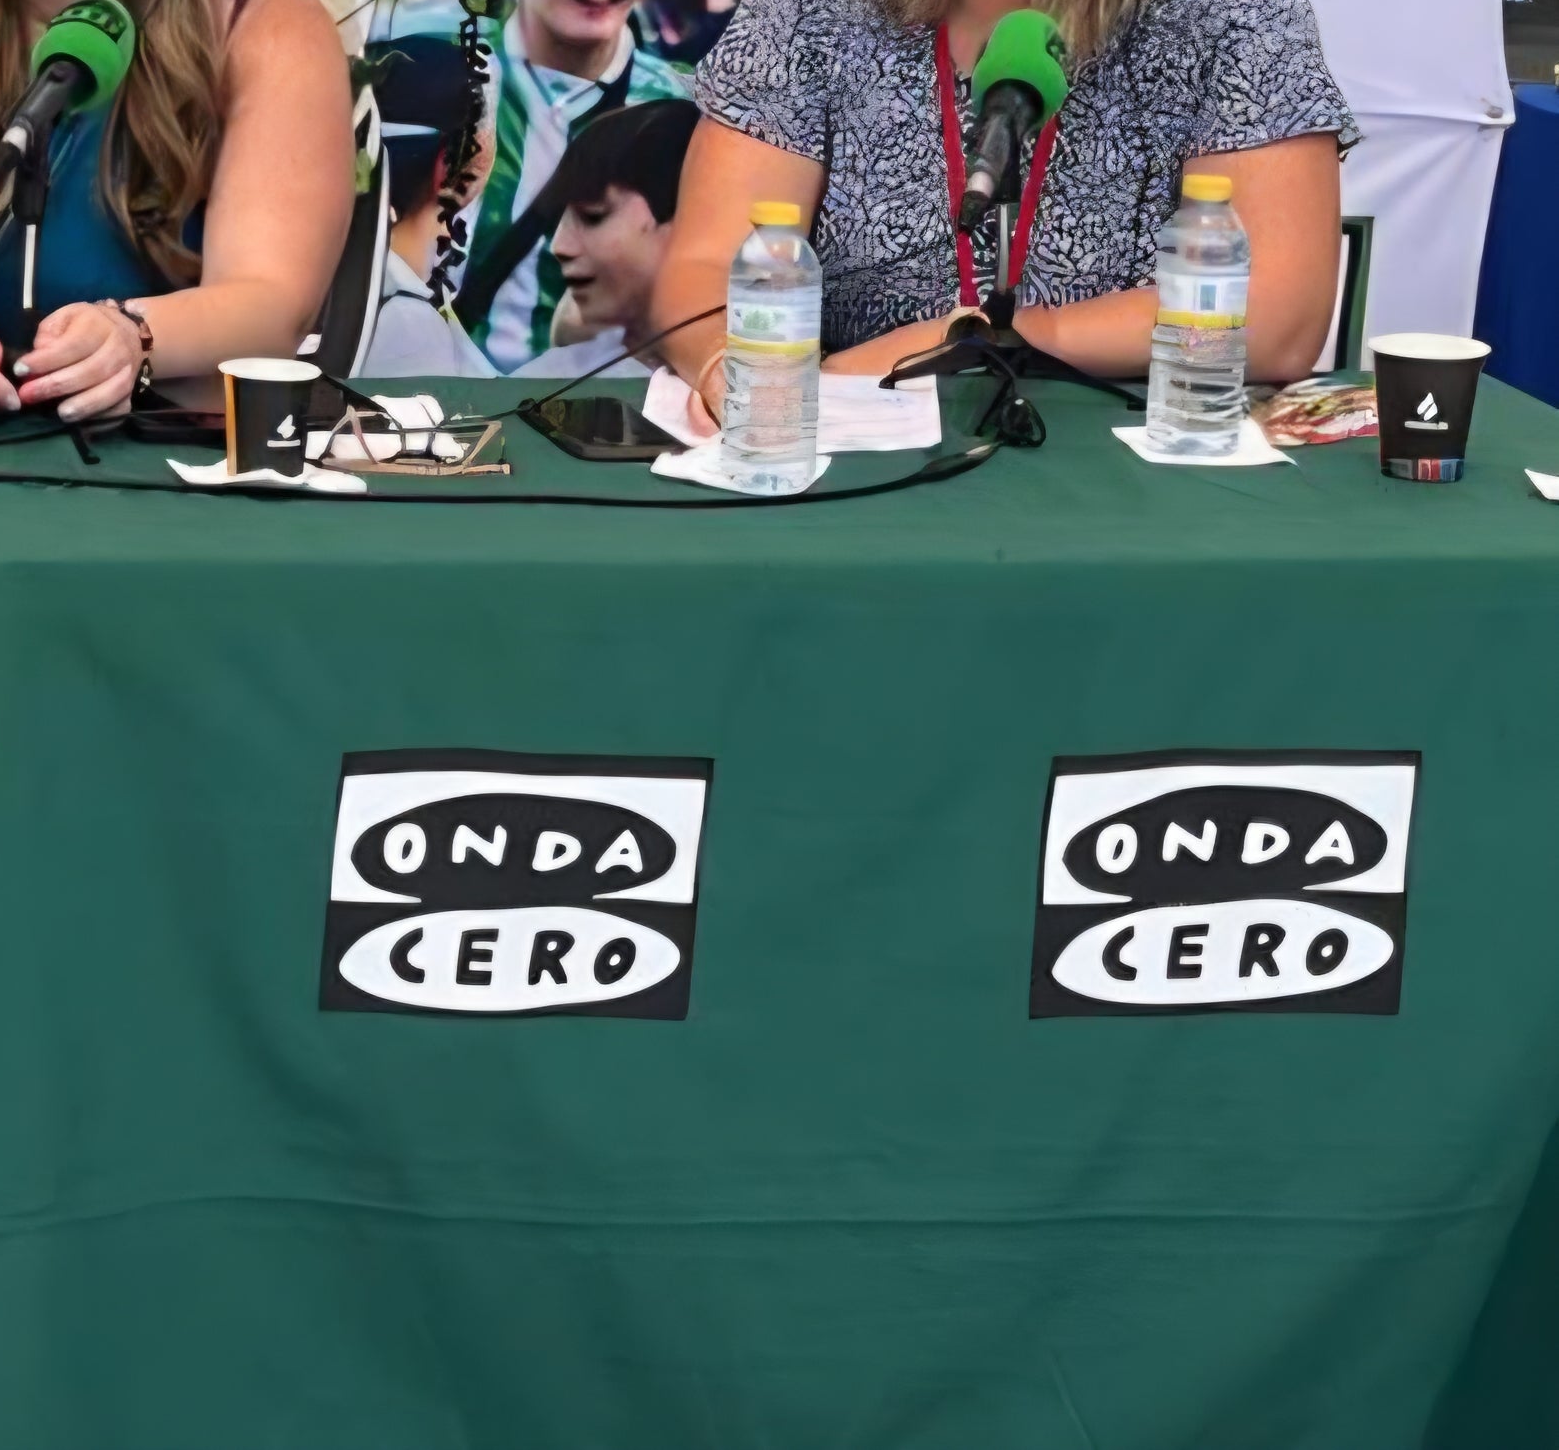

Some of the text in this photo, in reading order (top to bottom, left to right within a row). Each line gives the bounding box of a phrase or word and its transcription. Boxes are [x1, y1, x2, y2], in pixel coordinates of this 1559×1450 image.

[384, 822, 643, 874] ONDA
[1096, 820, 1355, 873] ONDA
[390, 927, 637, 986] CERO
[1102, 923, 1349, 981] CERO
